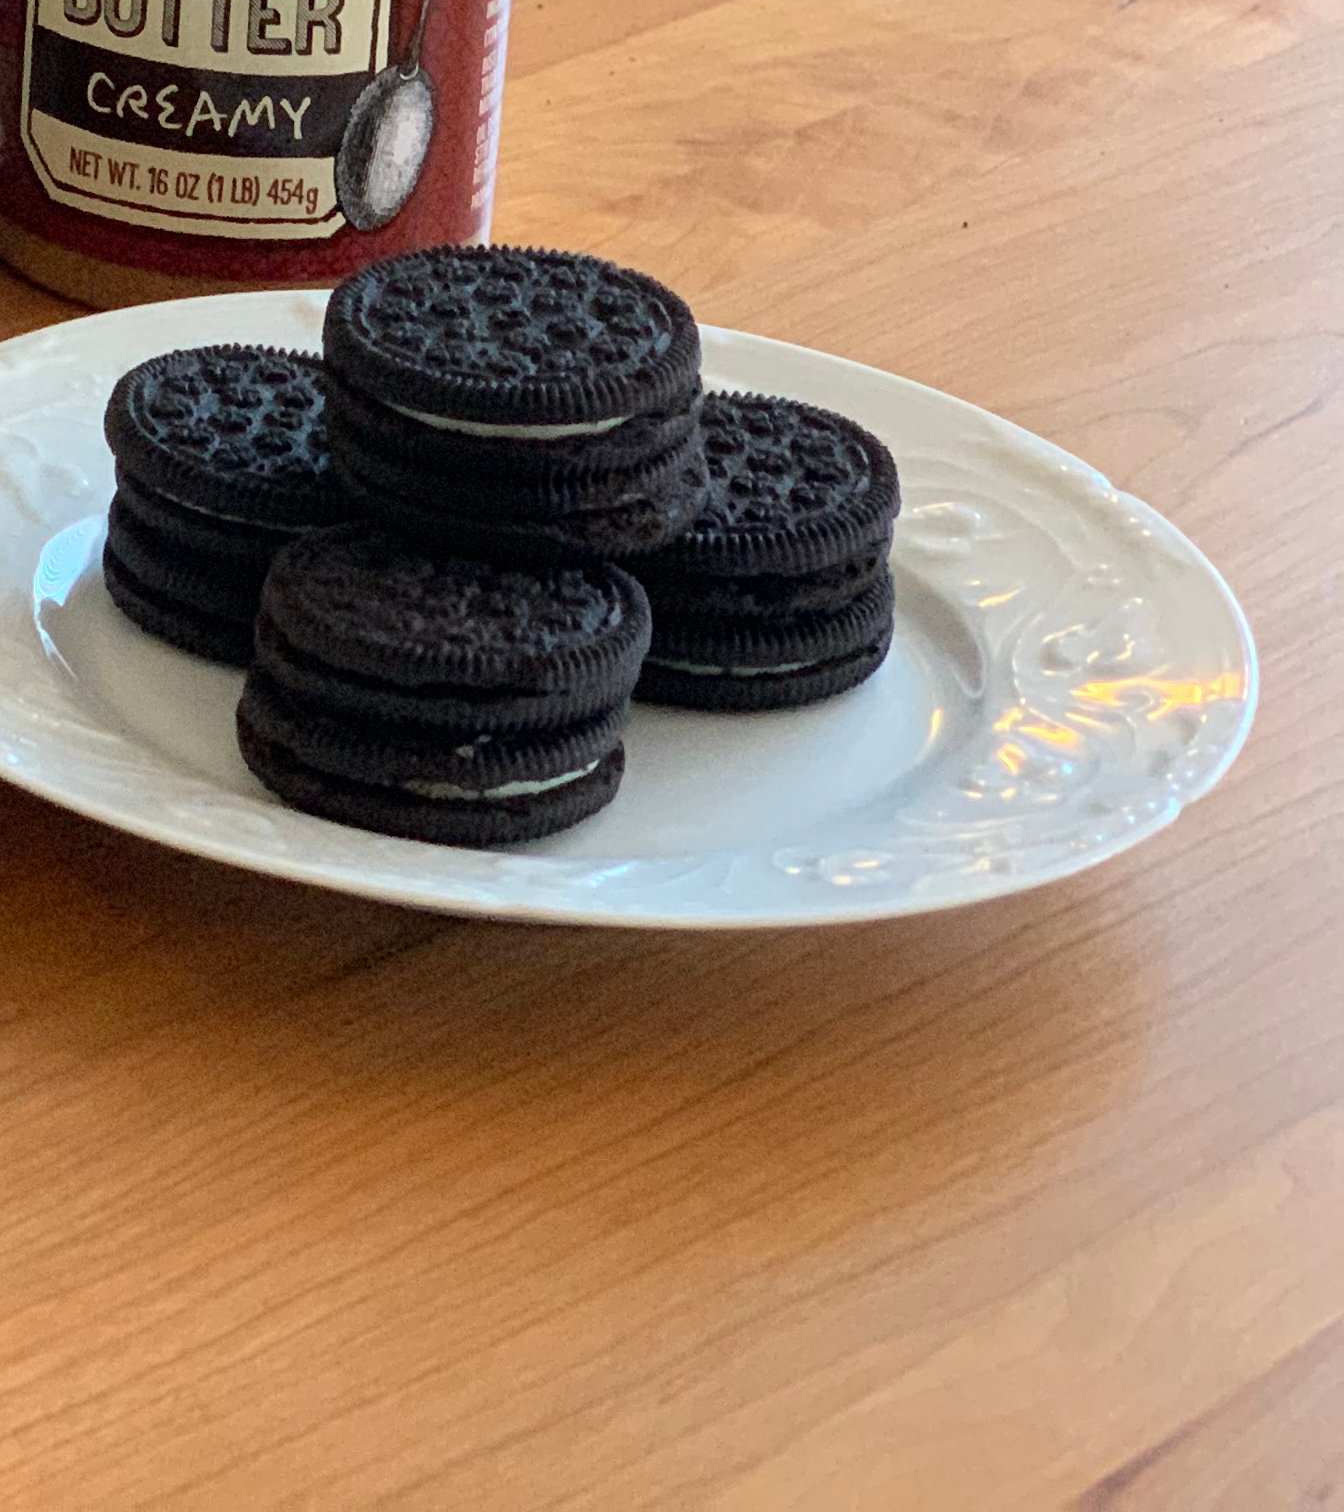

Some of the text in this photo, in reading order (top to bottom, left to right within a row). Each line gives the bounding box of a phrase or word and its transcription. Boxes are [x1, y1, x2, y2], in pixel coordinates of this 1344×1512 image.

[86, 72, 312, 139] CREAMY
[70, 147, 318, 213] NET WT. 16 OZ (1 LB) 454g
